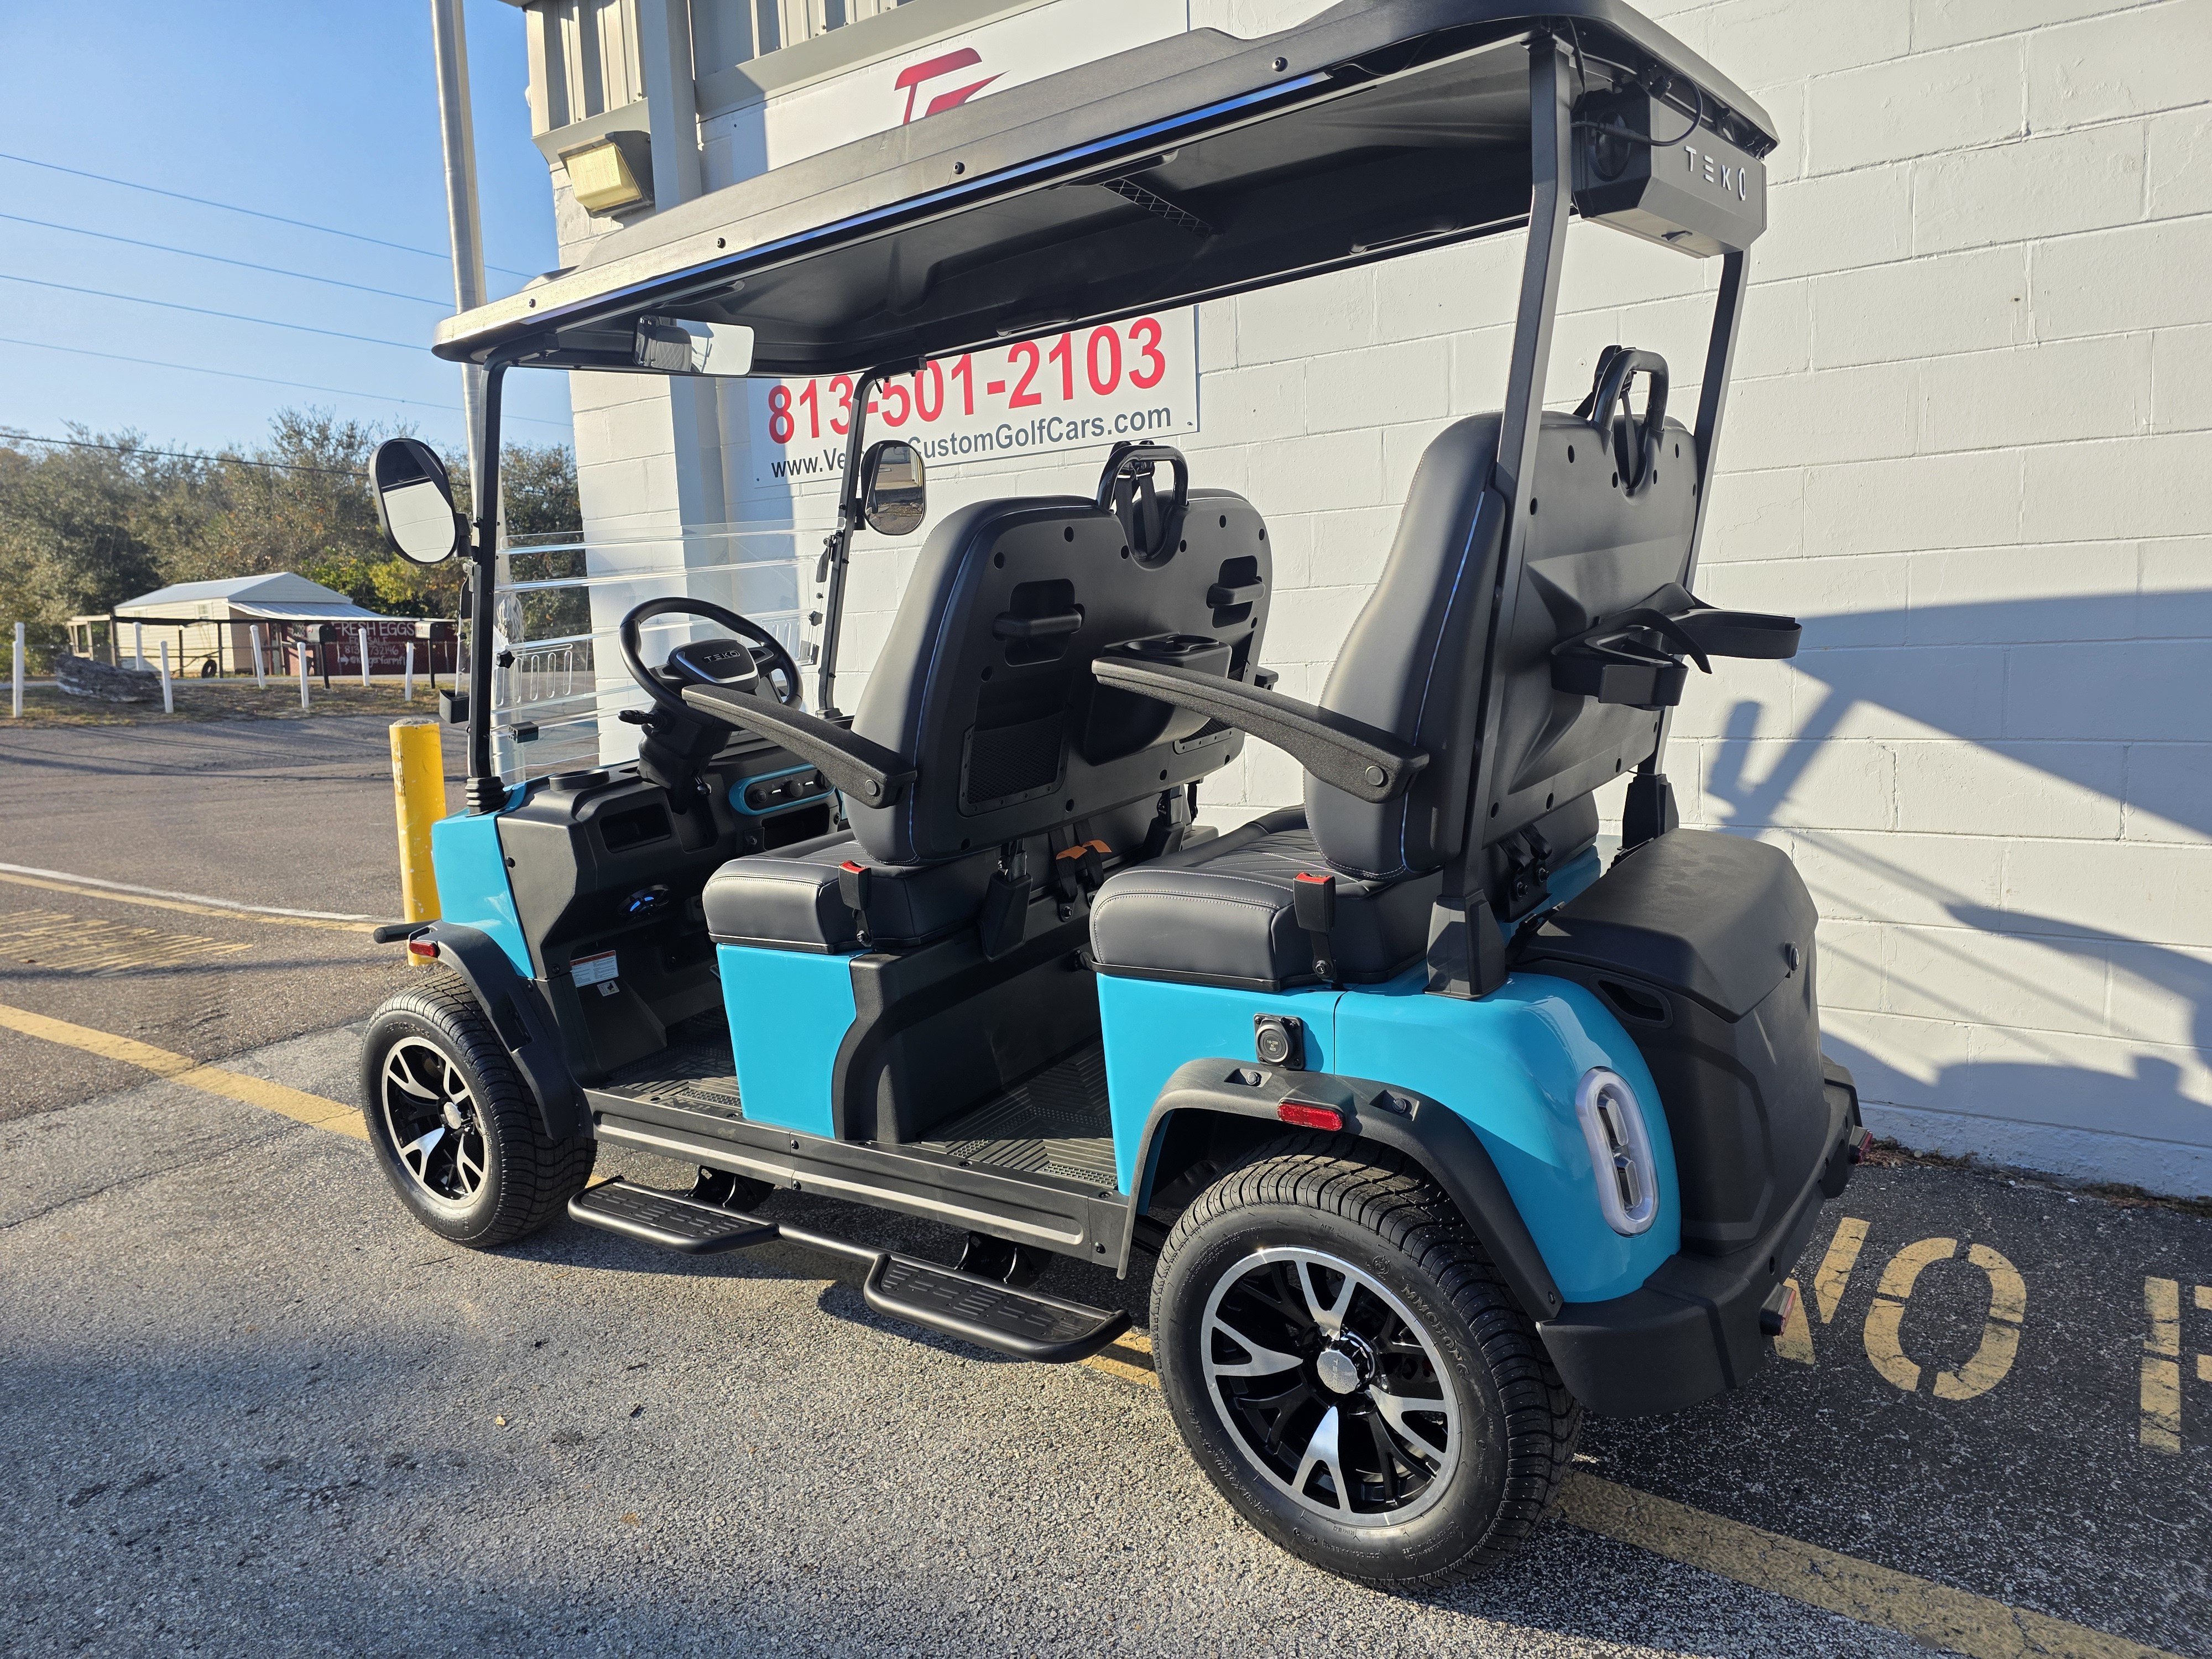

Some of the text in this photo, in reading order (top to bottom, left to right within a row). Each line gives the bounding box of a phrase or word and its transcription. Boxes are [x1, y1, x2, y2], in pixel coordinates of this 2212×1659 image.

[1684, 145, 1746, 201] TEKO
[379, 621, 415, 637] EGGS
[368, 637, 388, 646] SALE
[703, 651, 739, 662] TEKO
